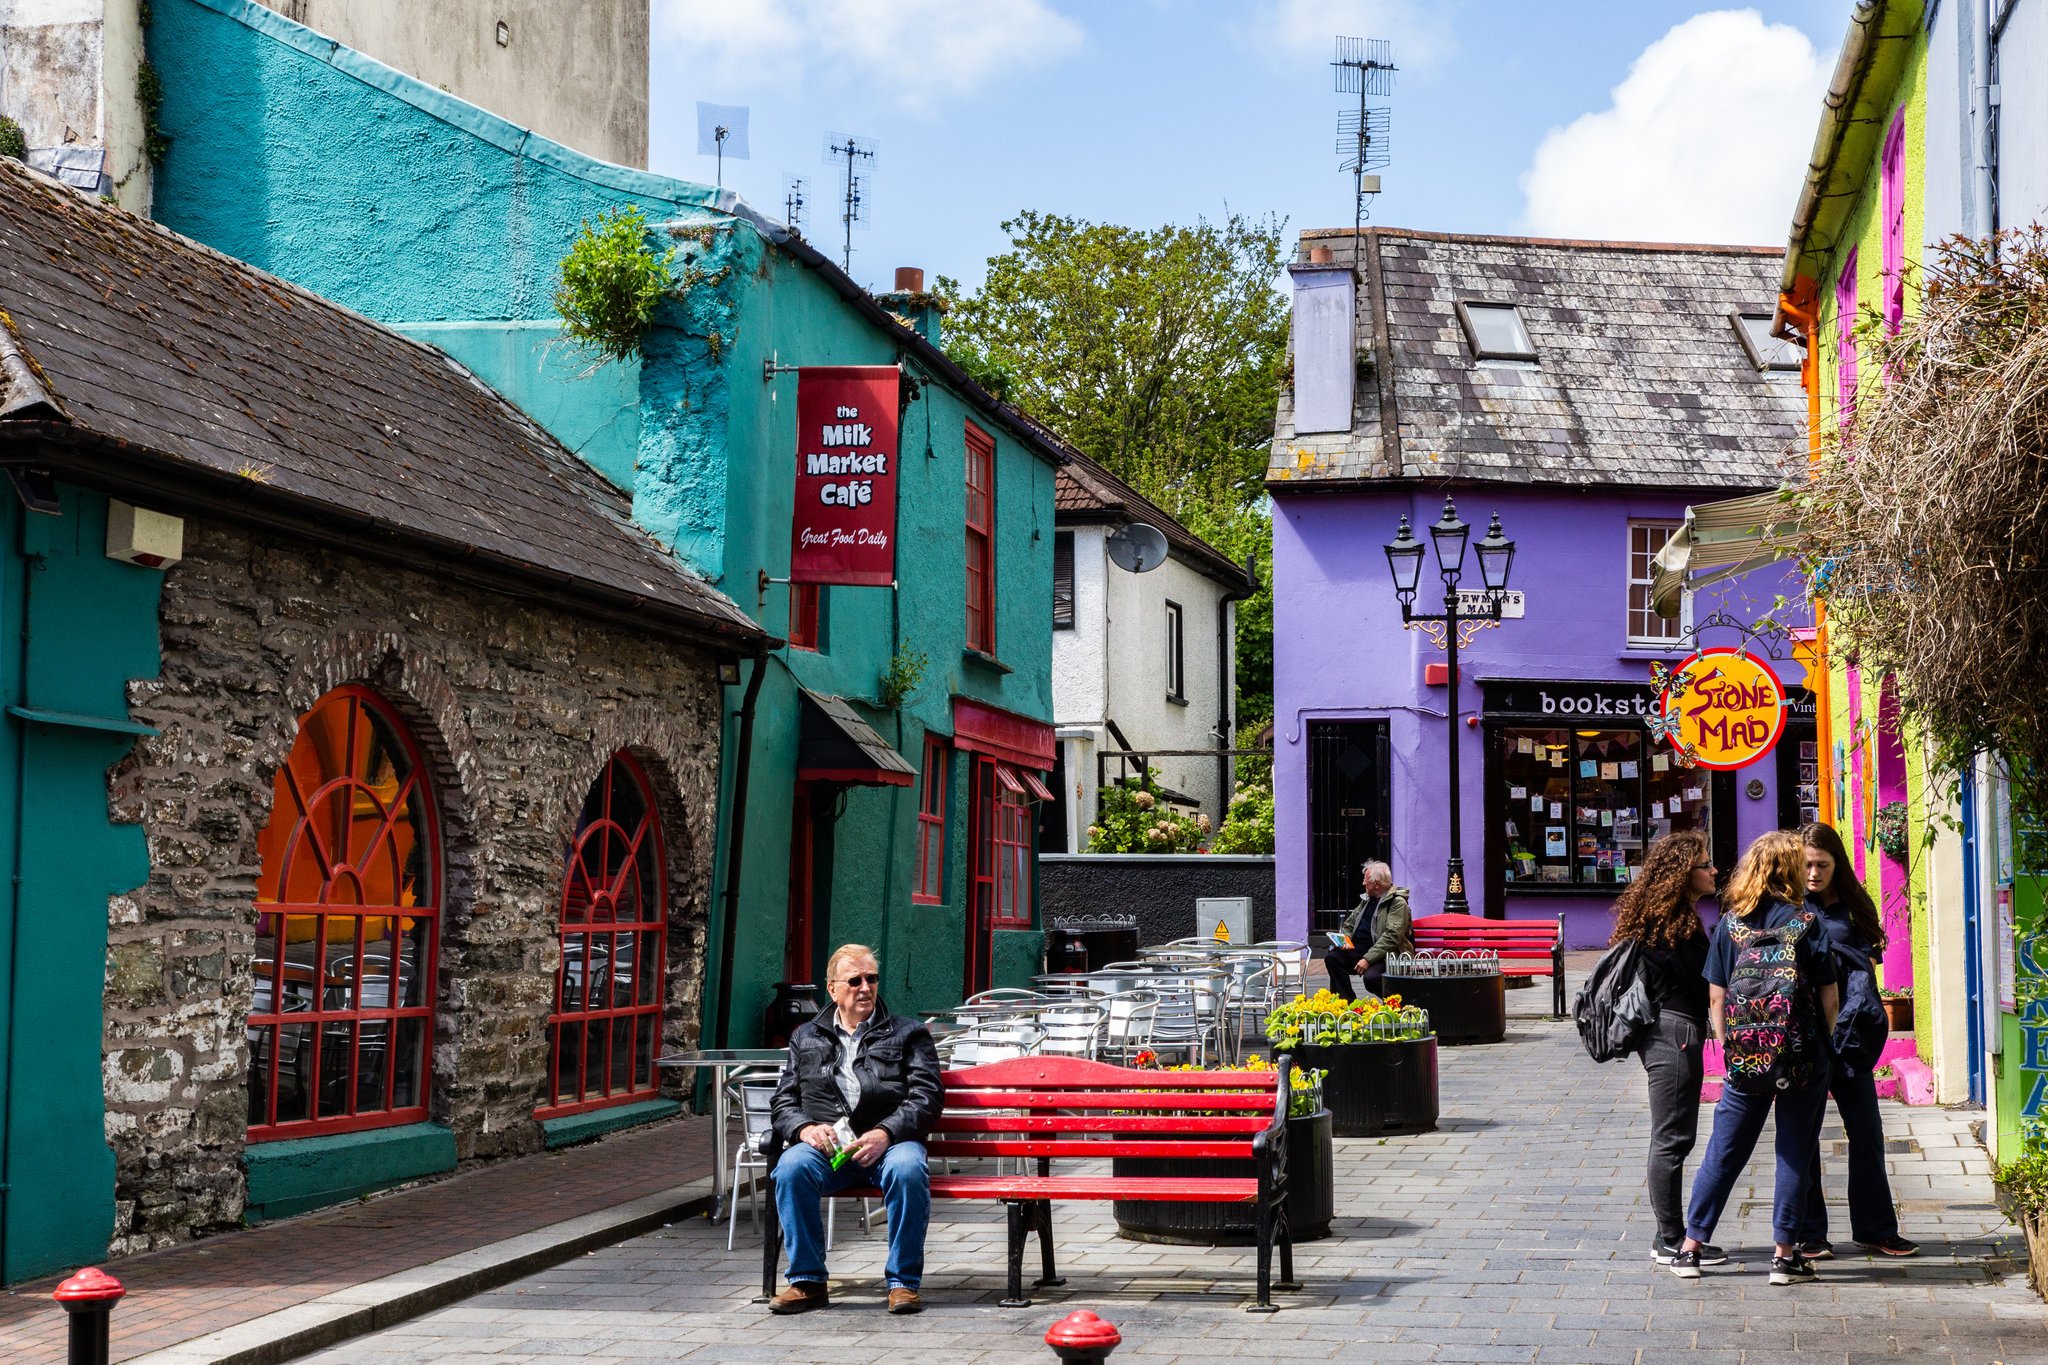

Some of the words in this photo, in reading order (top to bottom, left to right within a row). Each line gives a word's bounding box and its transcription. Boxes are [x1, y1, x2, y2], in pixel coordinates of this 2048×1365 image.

[836, 405, 858, 419] the
[822, 423, 872, 447] Milk
[806, 451, 887, 475] Market
[820, 479, 872, 507] Café
[800, 527, 829, 549] Great
[831, 528, 856, 546] Food
[857, 528, 888, 550] Daily
[1456, 593, 1521, 604] EWMN'S
[1467, 604, 1493, 614] MAL
[1686, 667, 1775, 725] STONE
[1698, 715, 1770, 752] MAD
